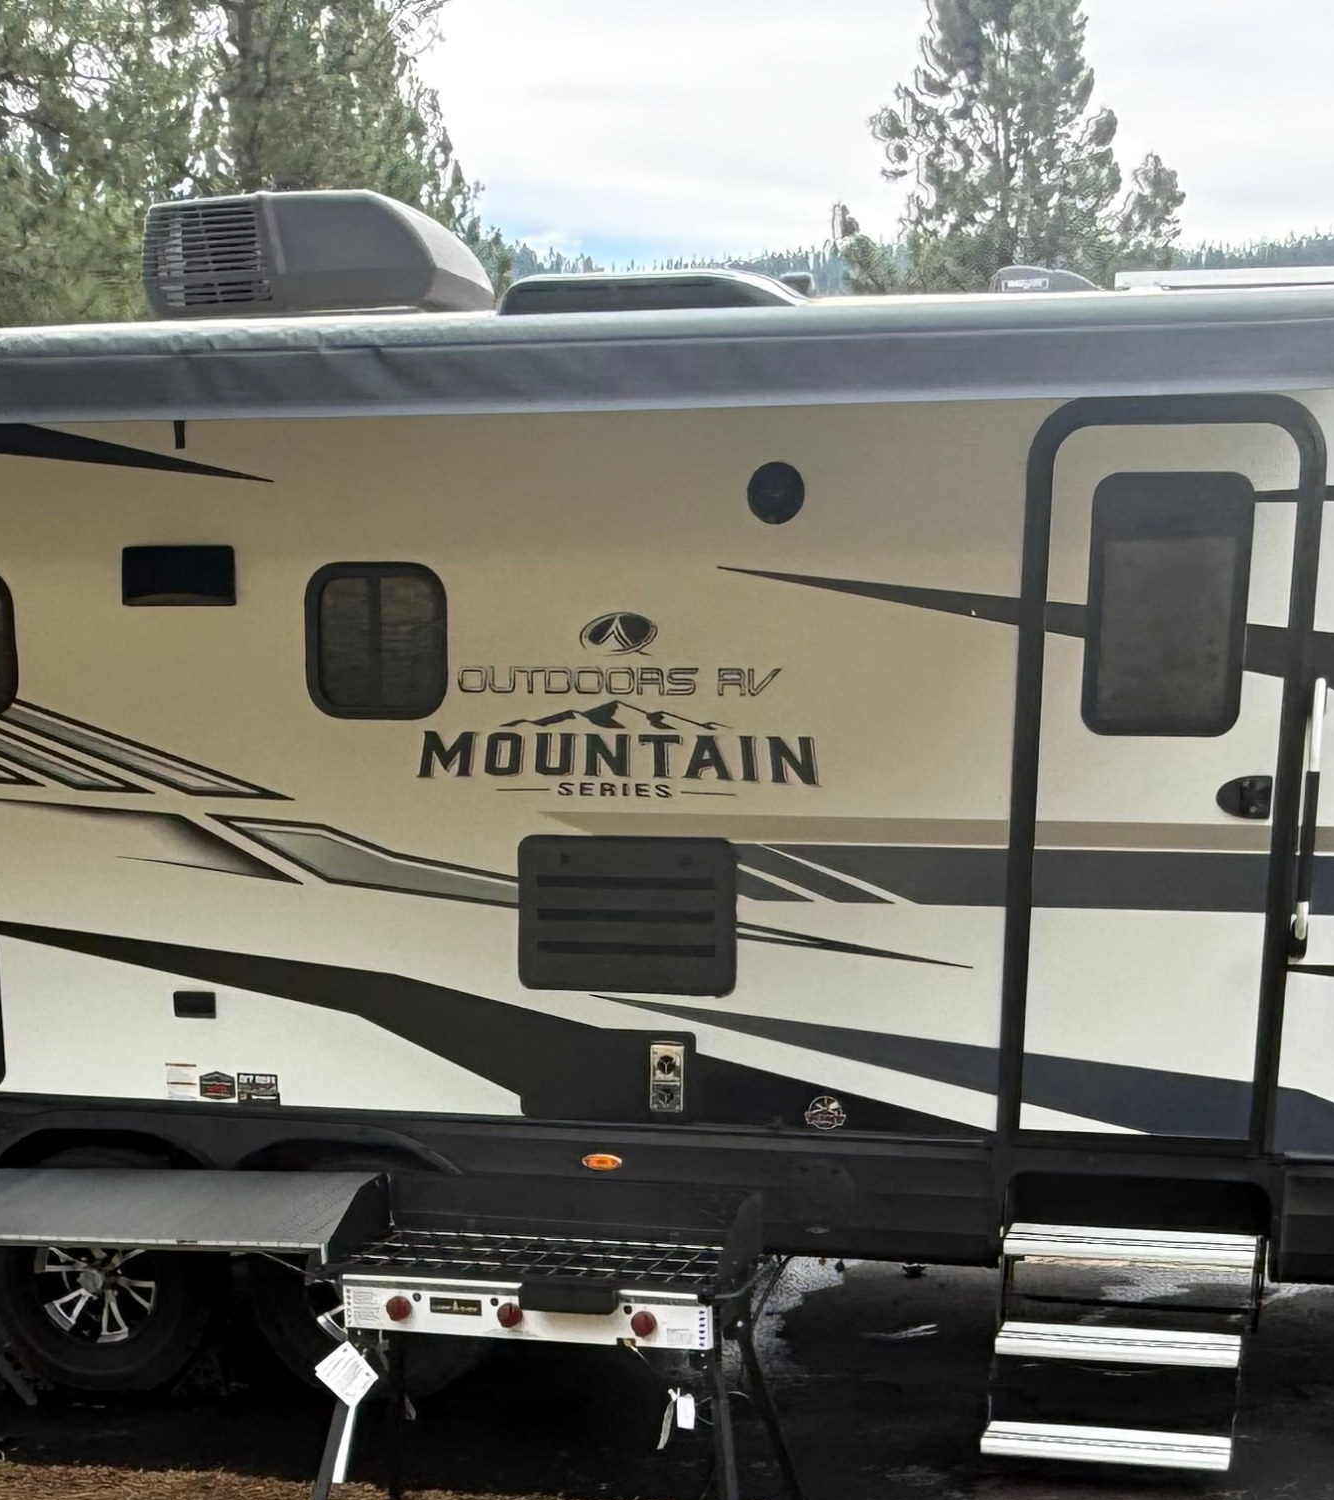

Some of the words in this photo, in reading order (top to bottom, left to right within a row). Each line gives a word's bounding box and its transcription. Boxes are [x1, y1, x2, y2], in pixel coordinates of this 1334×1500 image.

[457, 666, 699, 696] OUTDOORS
[717, 667, 782, 696] RV
[417, 730, 819, 785] MOUNTAIN
[556, 782, 674, 798] SERIES
